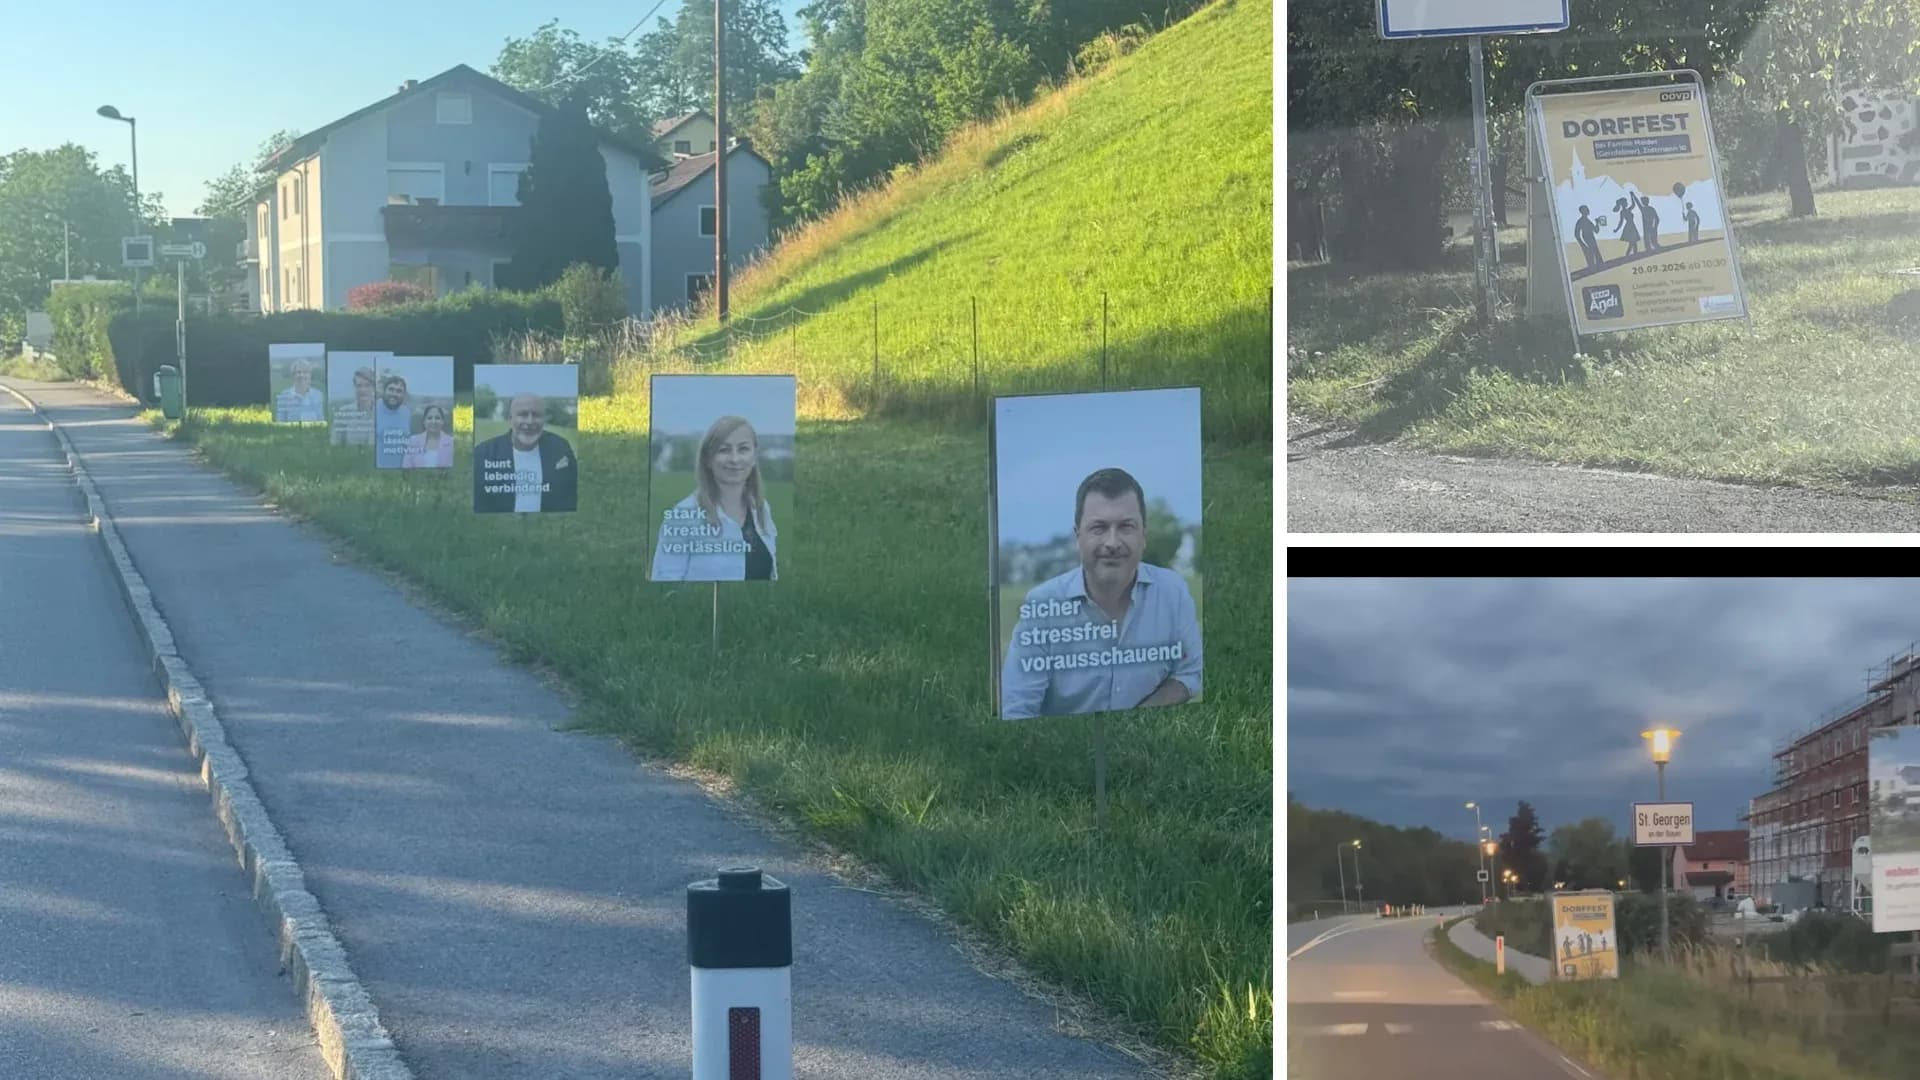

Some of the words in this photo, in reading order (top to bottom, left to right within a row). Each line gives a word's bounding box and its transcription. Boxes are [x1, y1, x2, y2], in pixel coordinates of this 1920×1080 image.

[1562, 113, 1689, 138] DORFFEST
[1632, 262, 1686, 275] 20.09.2026
[1590, 294, 1618, 314] Andi
[484, 459, 512, 469] bunt
[484, 471, 535, 483] lebendig
[484, 482, 550, 493] verbindend
[663, 507, 707, 520] stark
[663, 523, 721, 537] kreativ
[663, 540, 752, 553] verlässlich
[1019, 599, 1082, 619] sicher
[1020, 620, 1118, 646] stressfrei
[1020, 641, 1183, 672] vorausschauend
[1639, 812, 1651, 827] St.
[1653, 812, 1690, 829] Georgen
